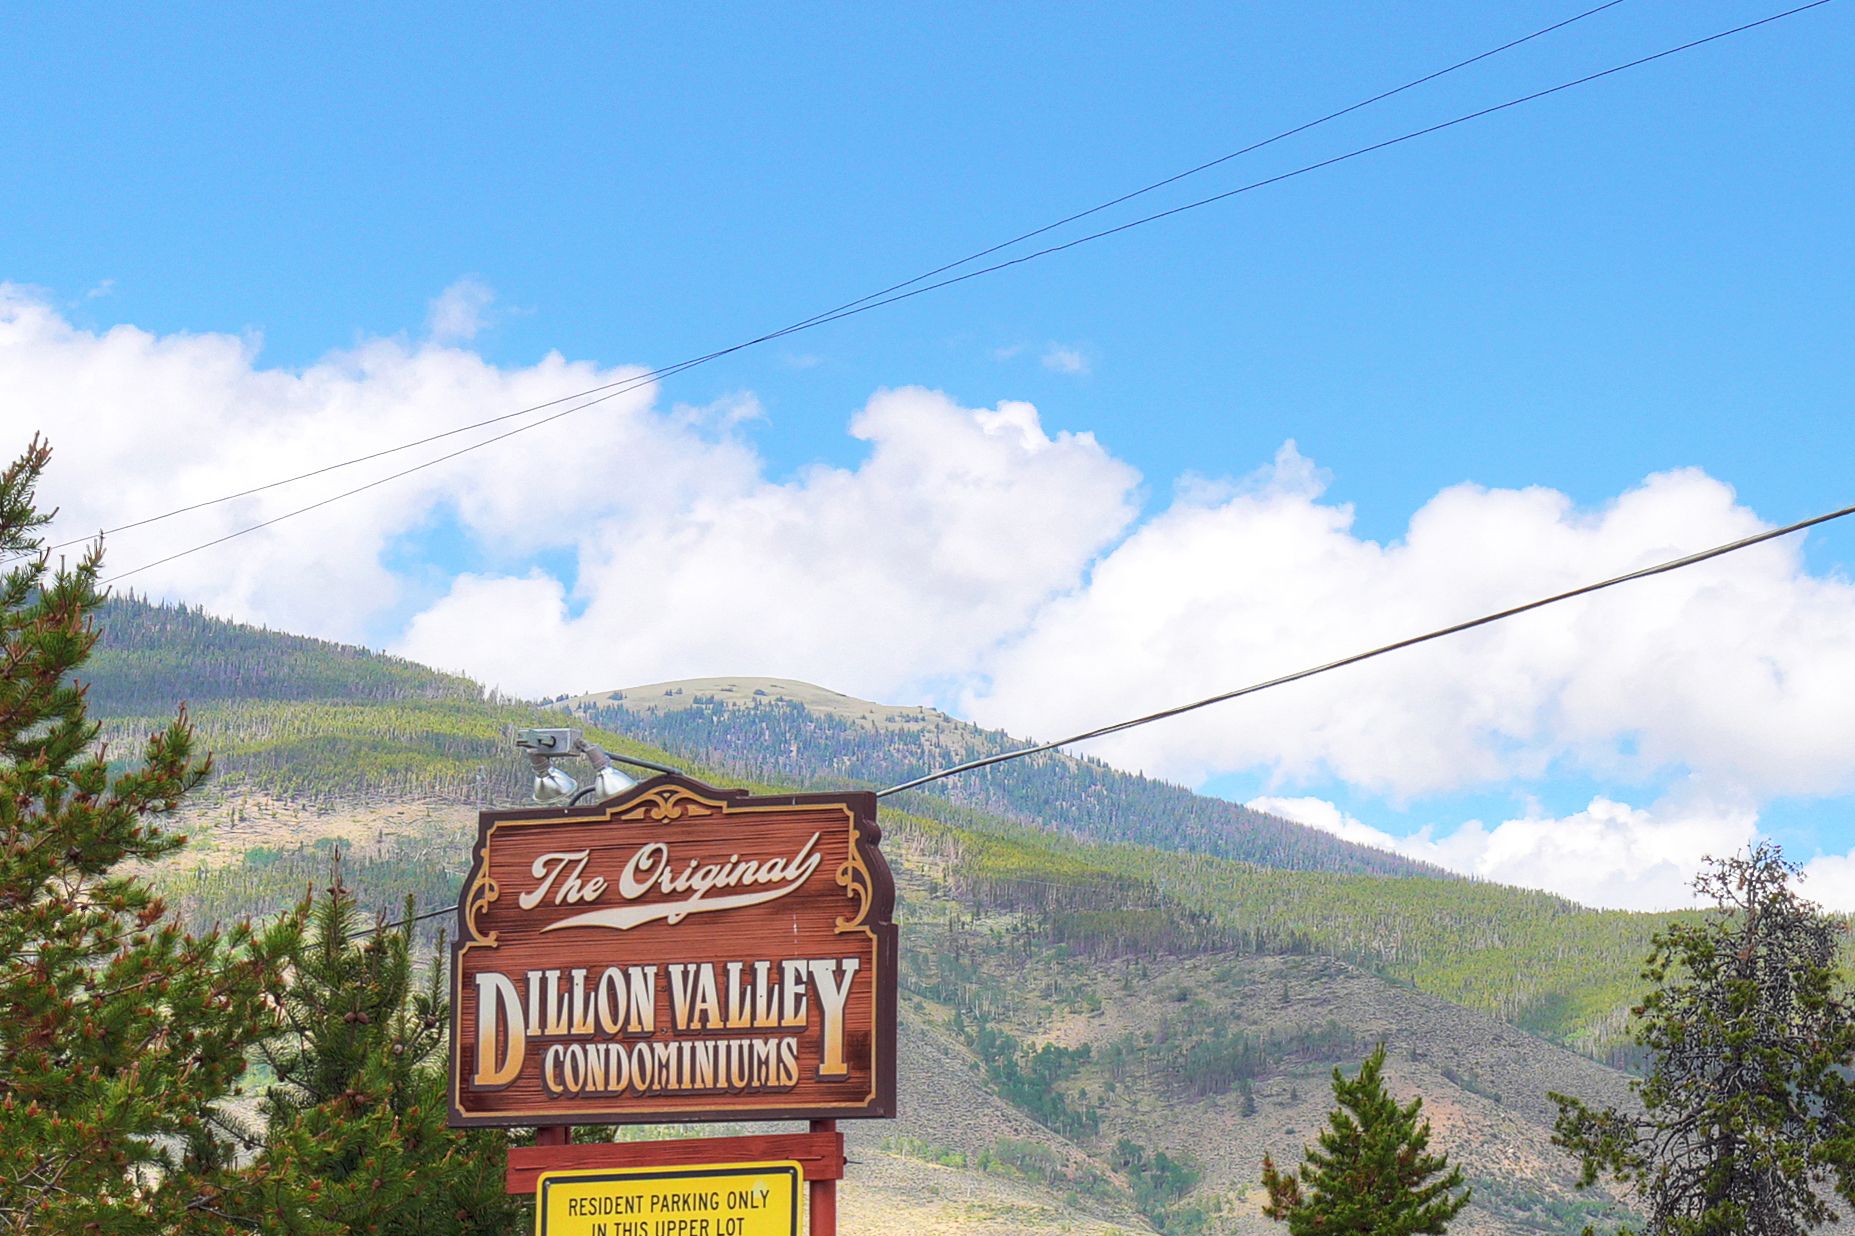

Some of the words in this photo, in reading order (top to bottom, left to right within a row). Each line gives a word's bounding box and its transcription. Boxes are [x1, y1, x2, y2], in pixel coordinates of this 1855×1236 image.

[519, 849, 607, 910] The
[619, 832, 821, 924] Original
[474, 965, 657, 1086] DILLON
[668, 958, 860, 1075] VALLEY
[545, 1038, 798, 1092] CONDOMINIUMS
[569, 1195, 643, 1216] RESIDENT
[651, 1192, 719, 1212] PARKING
[727, 1190, 770, 1209] ONLY
[717, 1218, 744, 1236] LOT
